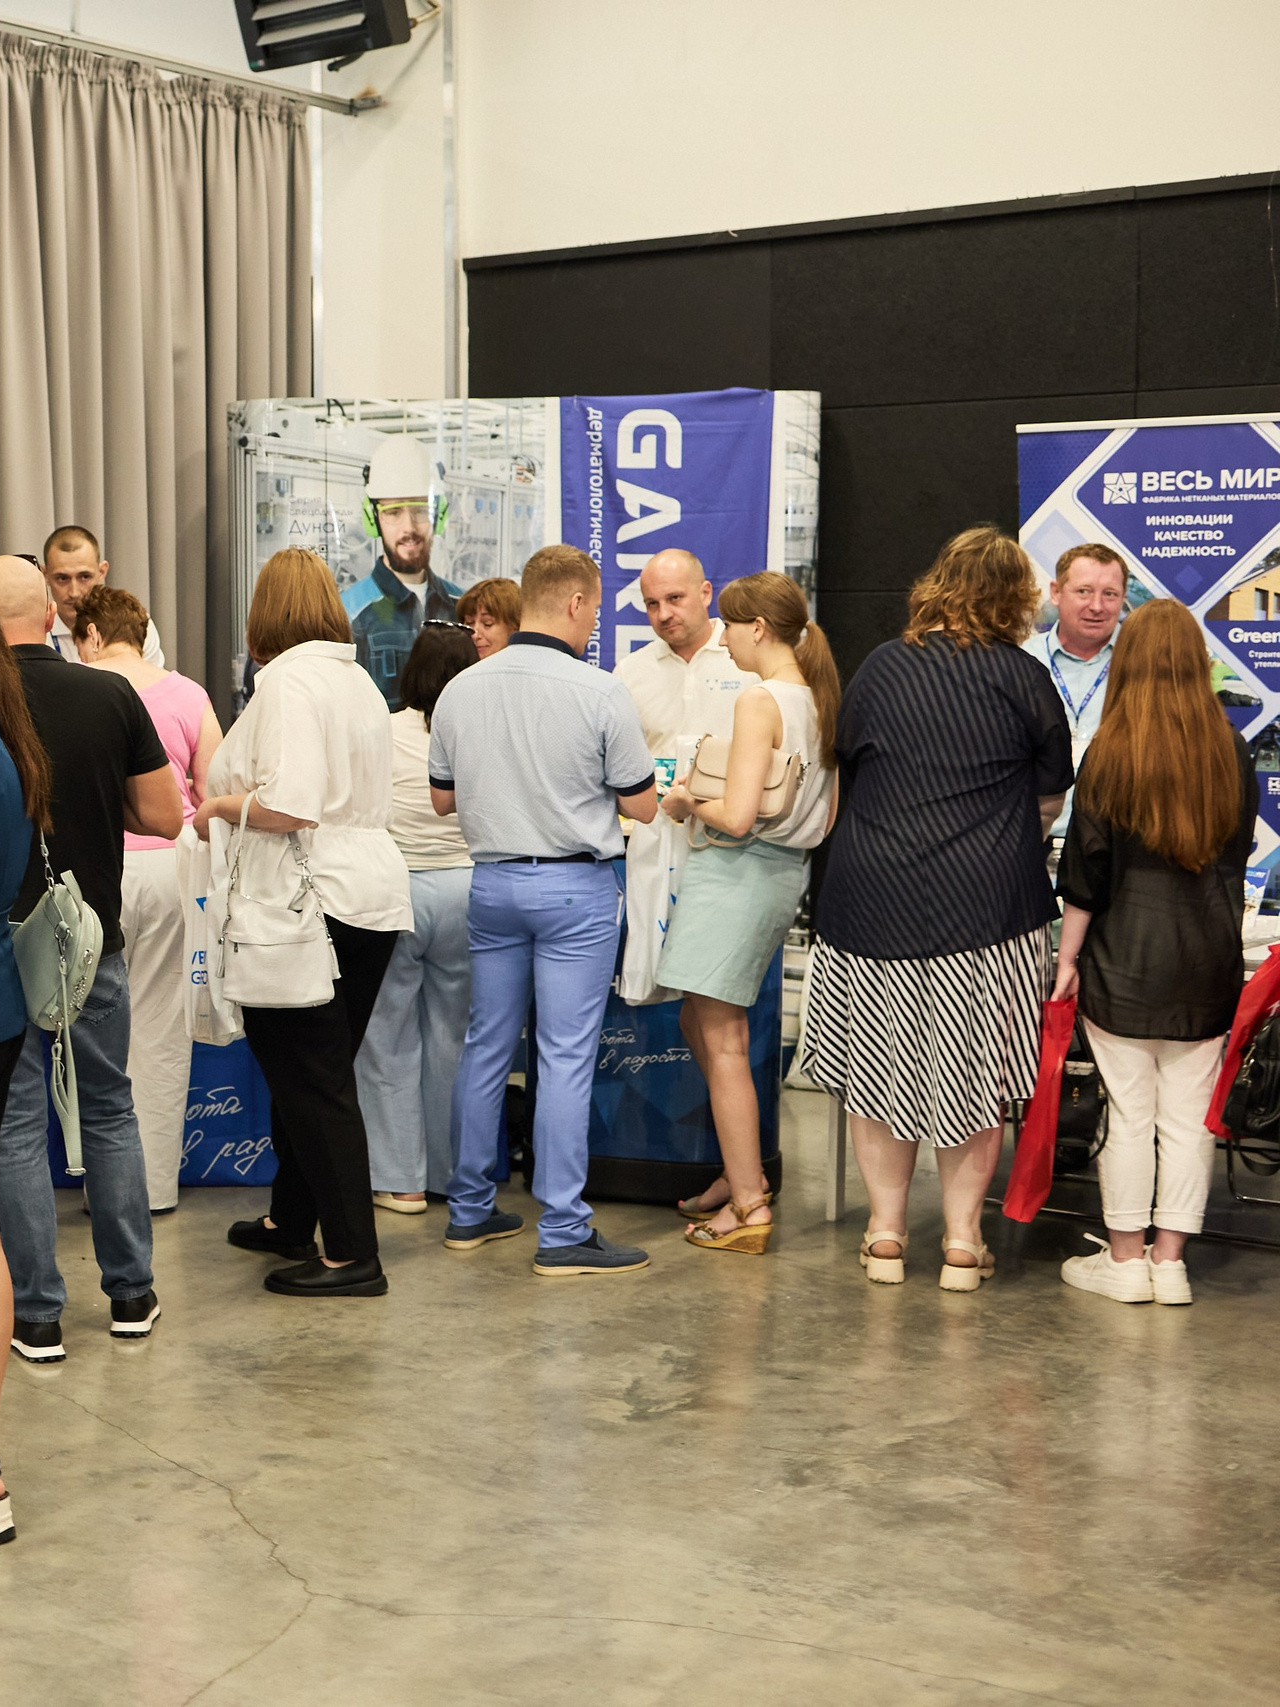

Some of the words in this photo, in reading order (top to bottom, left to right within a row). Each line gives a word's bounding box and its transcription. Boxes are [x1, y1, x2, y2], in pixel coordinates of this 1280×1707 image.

[1142, 470, 1213, 492] ВЕСЬ
[1145, 514, 1233, 526] ИННОВАЦИИ
[1154, 530, 1224, 541] КАЧЕСТВО
[1142, 546, 1237, 558] НАДЕЖНОСТЬ
[599, 1028, 636, 1045] бота
